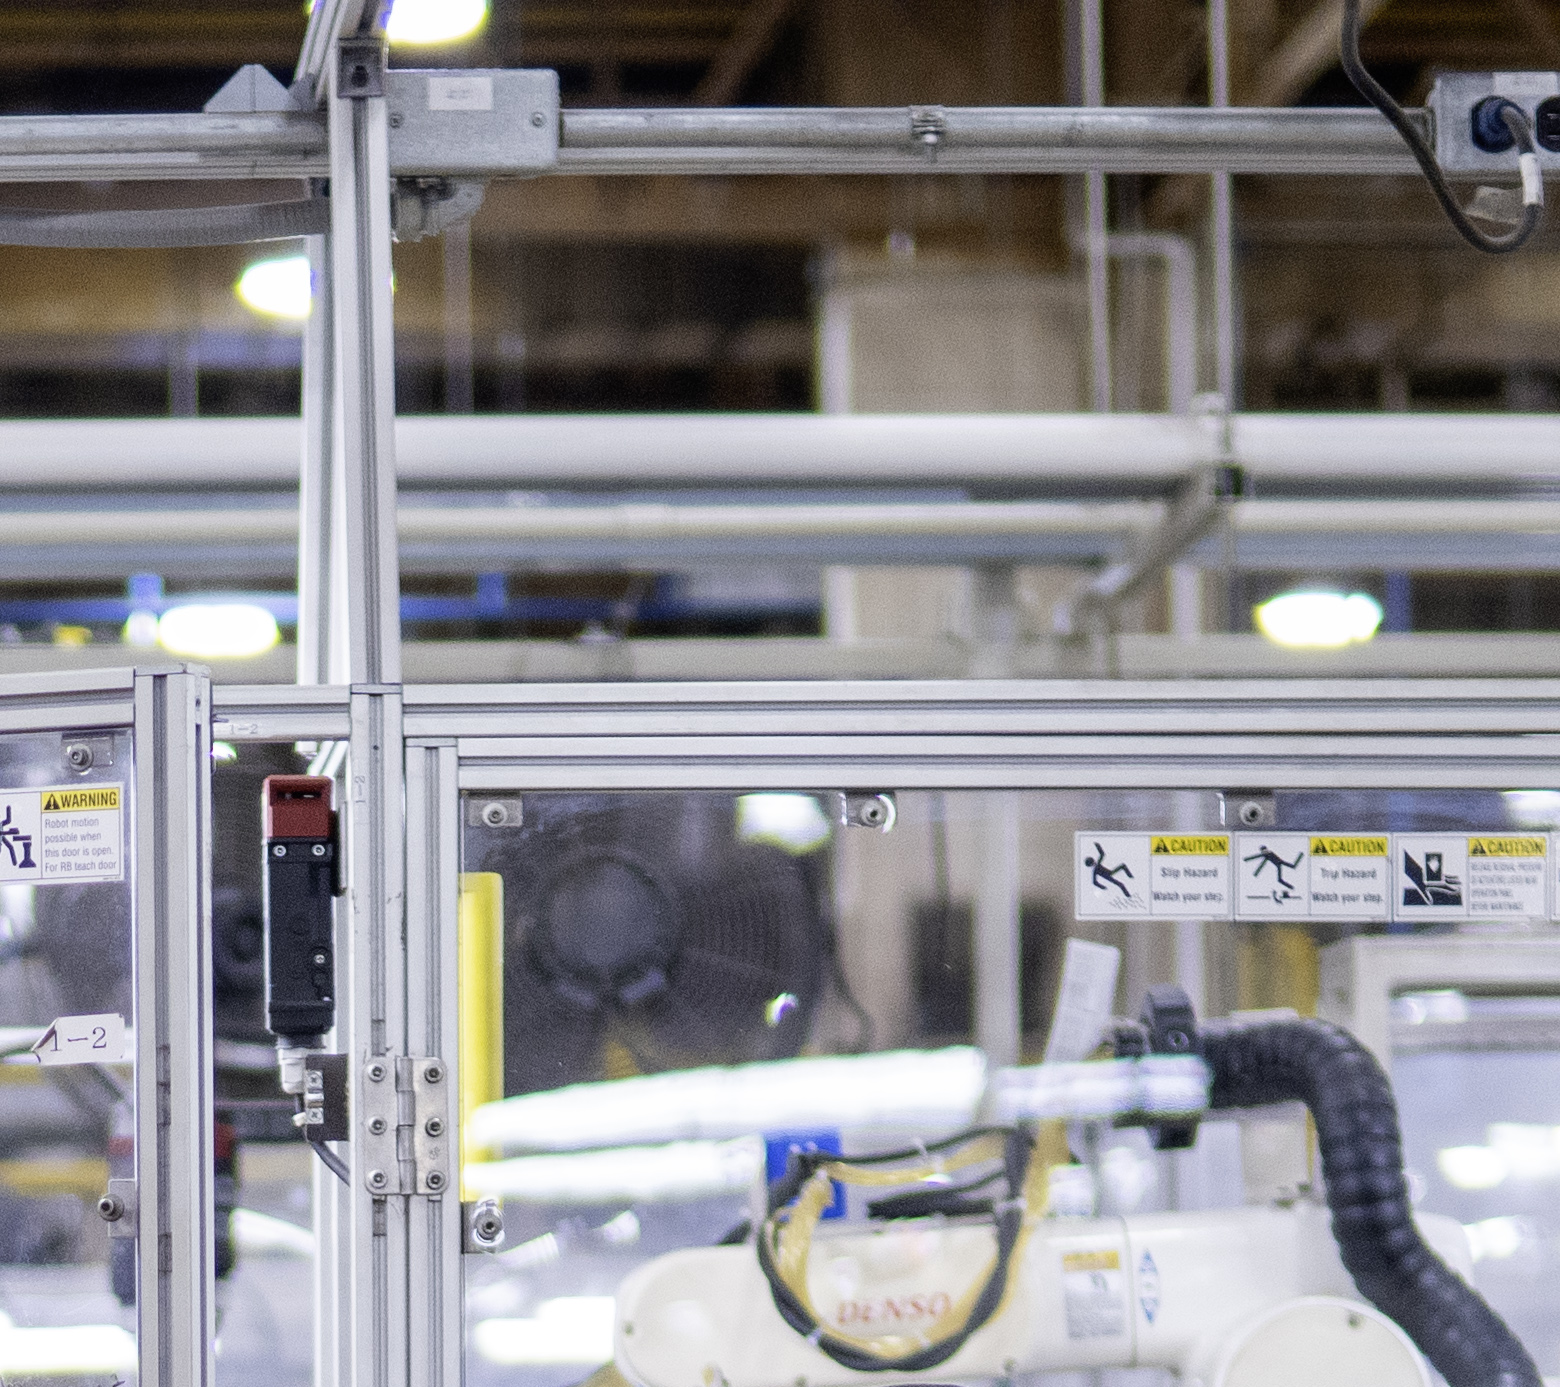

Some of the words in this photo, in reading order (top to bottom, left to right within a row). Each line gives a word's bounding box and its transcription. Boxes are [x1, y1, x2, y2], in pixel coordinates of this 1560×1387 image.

[230, 724, 258, 734] 1-2
[61, 792, 117, 809] WARNING
[45, 818, 69, 828] Robot
[72, 817, 99, 827] motion
[45, 832, 77, 844] possible
[79, 831, 101, 841] when
[1170, 838, 1226, 852] CAUTION
[1330, 838, 1385, 853] CAUTION
[1488, 840, 1543, 854] CAUTION
[45, 848, 60, 858] this
[62, 847, 81, 857] door
[83, 847, 90, 856] is
[45, 862, 59, 872] For
[75, 861, 95, 871] teach
[97, 860, 117, 870] door
[50, 1027, 106, 1051] 1-2
[838, 1292, 950, 1324] DENSO
